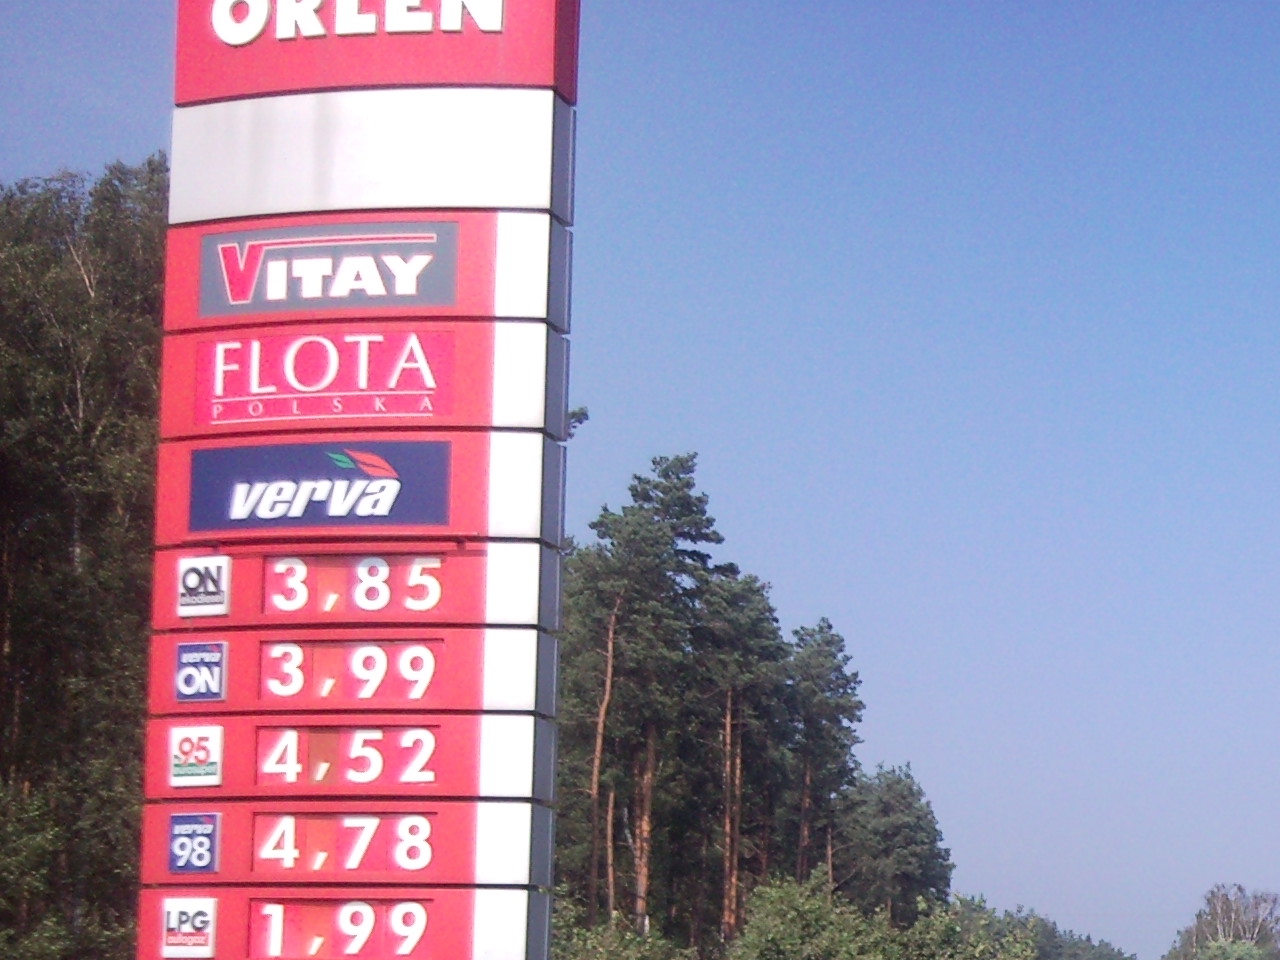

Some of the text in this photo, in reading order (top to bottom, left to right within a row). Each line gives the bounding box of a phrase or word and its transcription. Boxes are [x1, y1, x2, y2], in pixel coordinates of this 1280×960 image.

[211, 0, 503, 47] ORLEN
[213, 332, 437, 397] FLOTA
[211, 395, 434, 420] POLSKA
[229, 477, 401, 520] verva
[182, 566, 223, 597] ON
[271, 557, 443, 612] 3,85
[177, 666, 221, 695] ON
[267, 643, 437, 700] 3,99
[178, 736, 211, 766] 95
[262, 729, 436, 784] 4,52
[171, 836, 212, 867] 98
[259, 815, 433, 871] 4,78
[166, 910, 210, 932] LPG
[260, 901, 429, 957] 1,99
